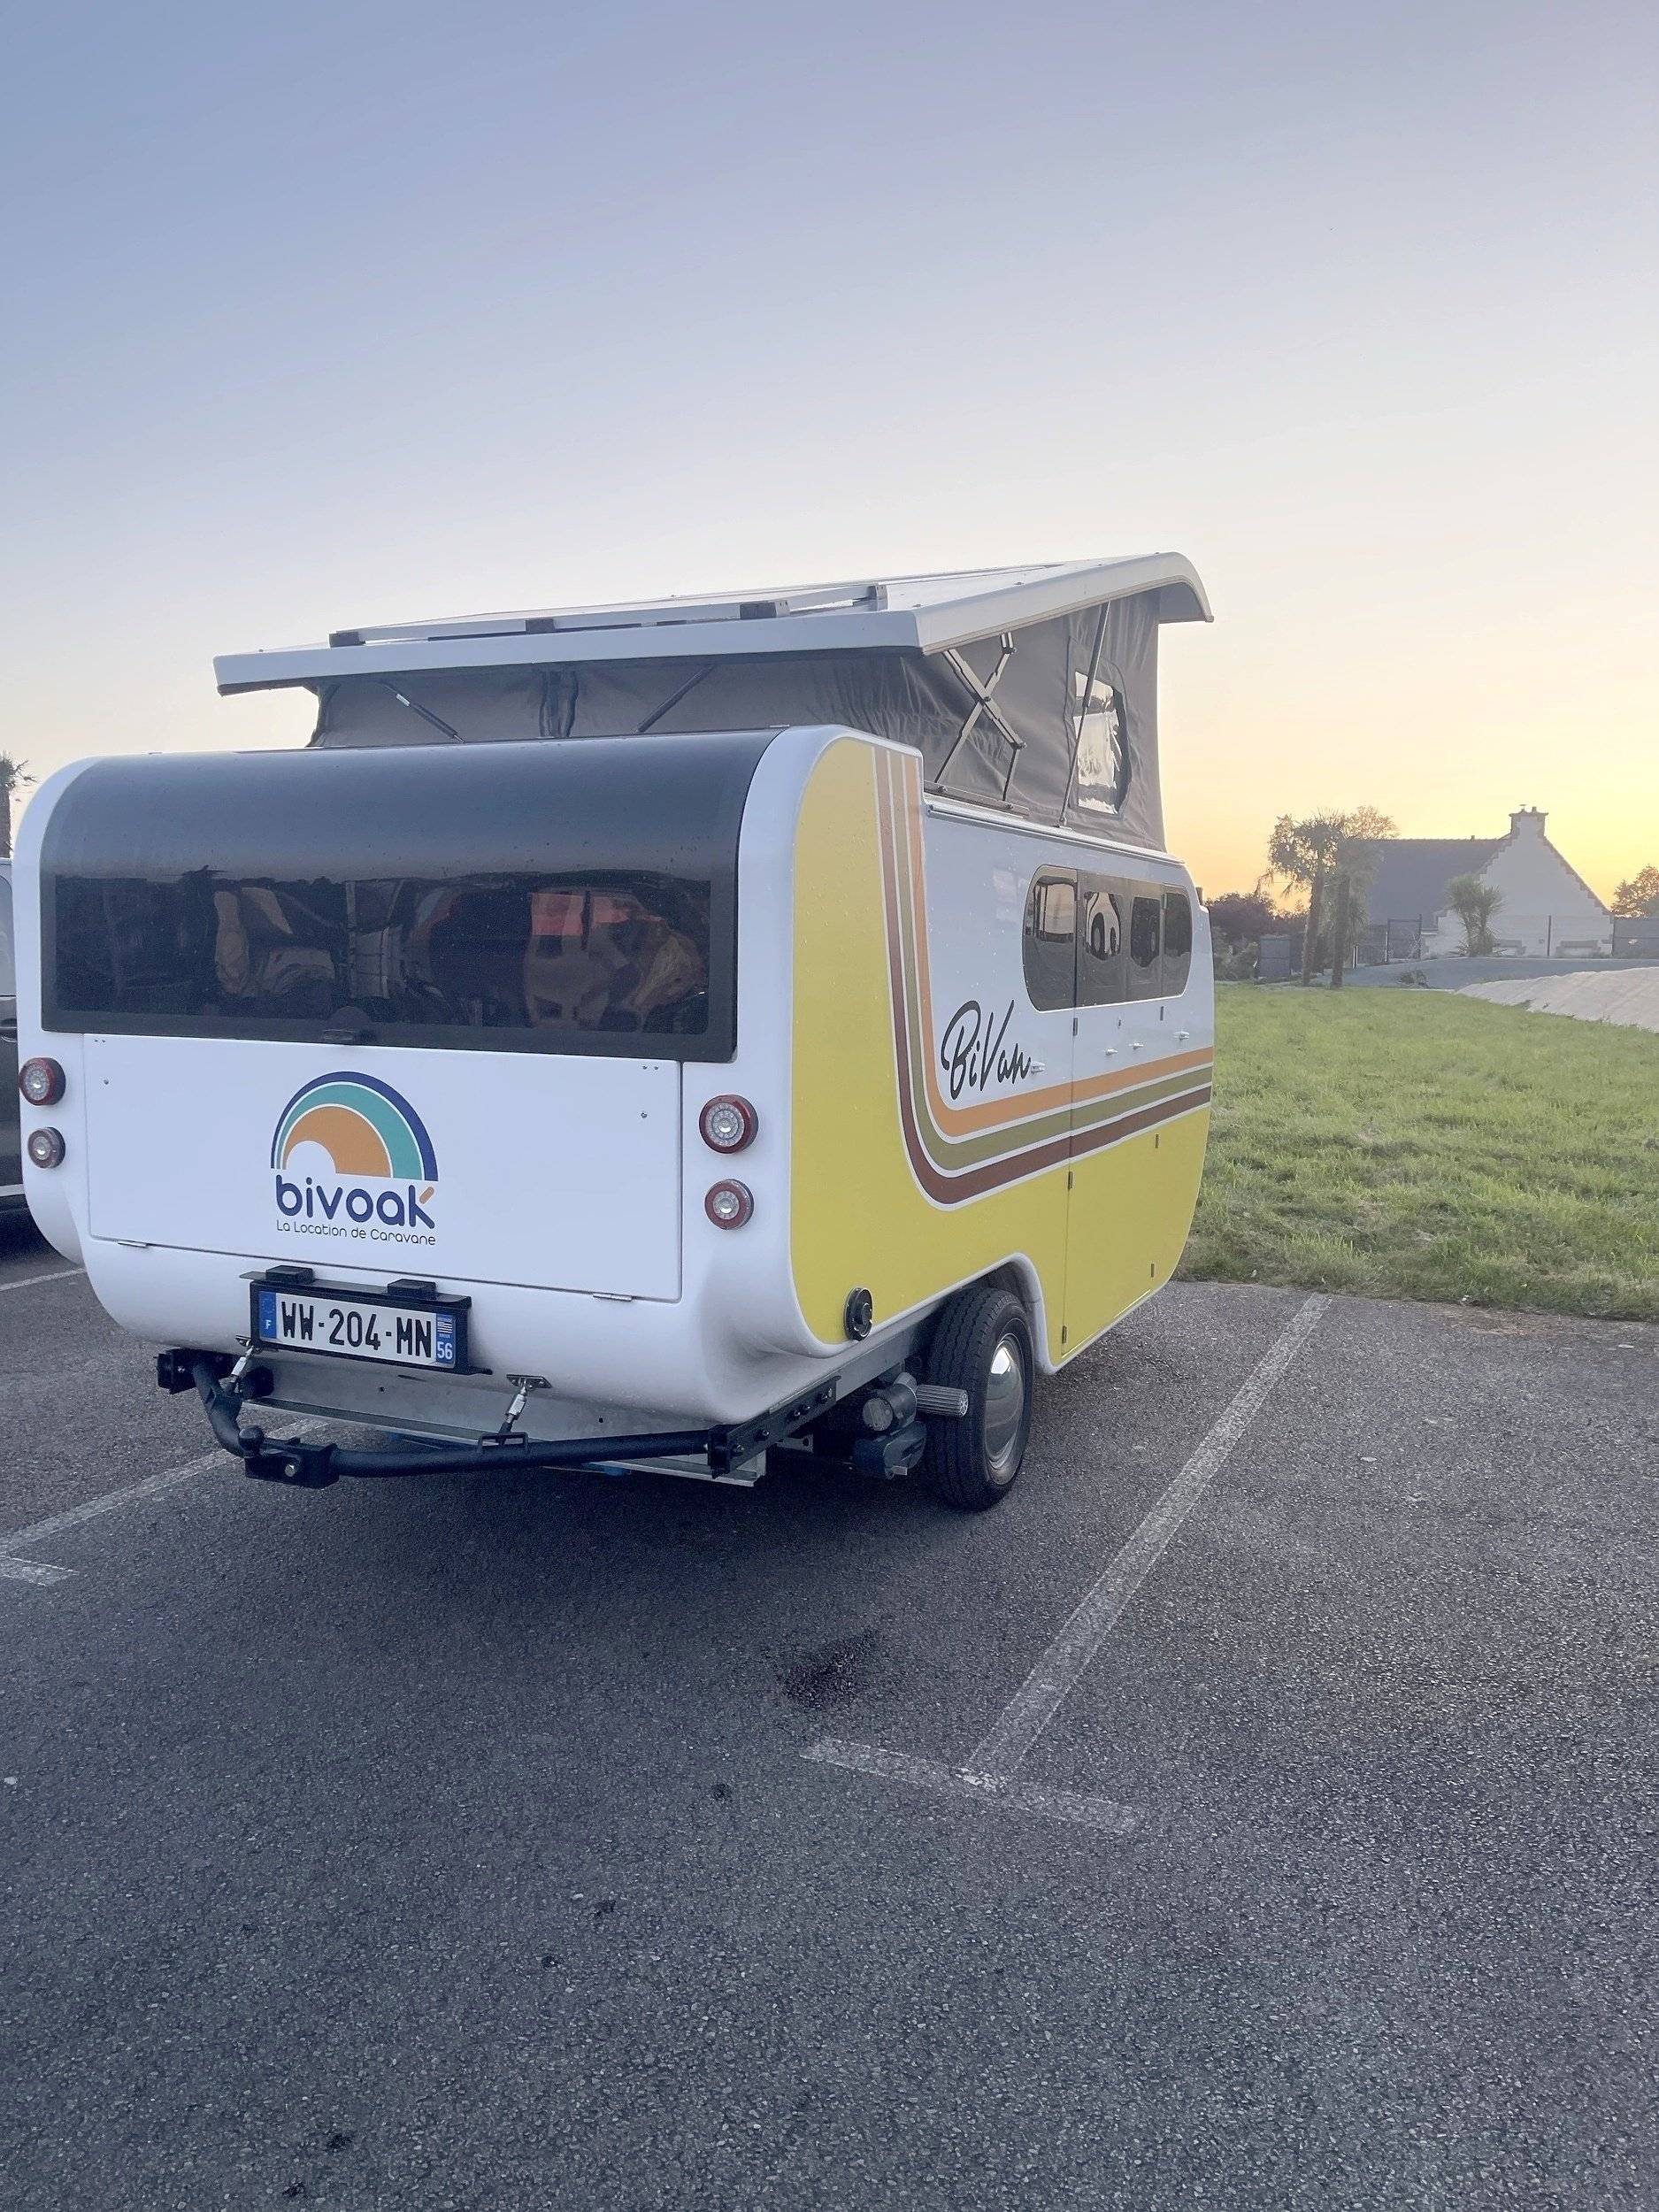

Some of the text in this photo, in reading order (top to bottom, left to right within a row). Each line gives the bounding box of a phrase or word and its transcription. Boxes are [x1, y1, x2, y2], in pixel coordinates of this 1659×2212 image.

[941, 1000, 1032, 1100] BiVan
[275, 1174, 436, 1230] bivoak
[276, 1219, 436, 1246] La Location de Caravane
[265, 1318, 273, 1330] F
[280, 1301, 433, 1358] WW-204-MN
[436, 1340, 453, 1361] 56
